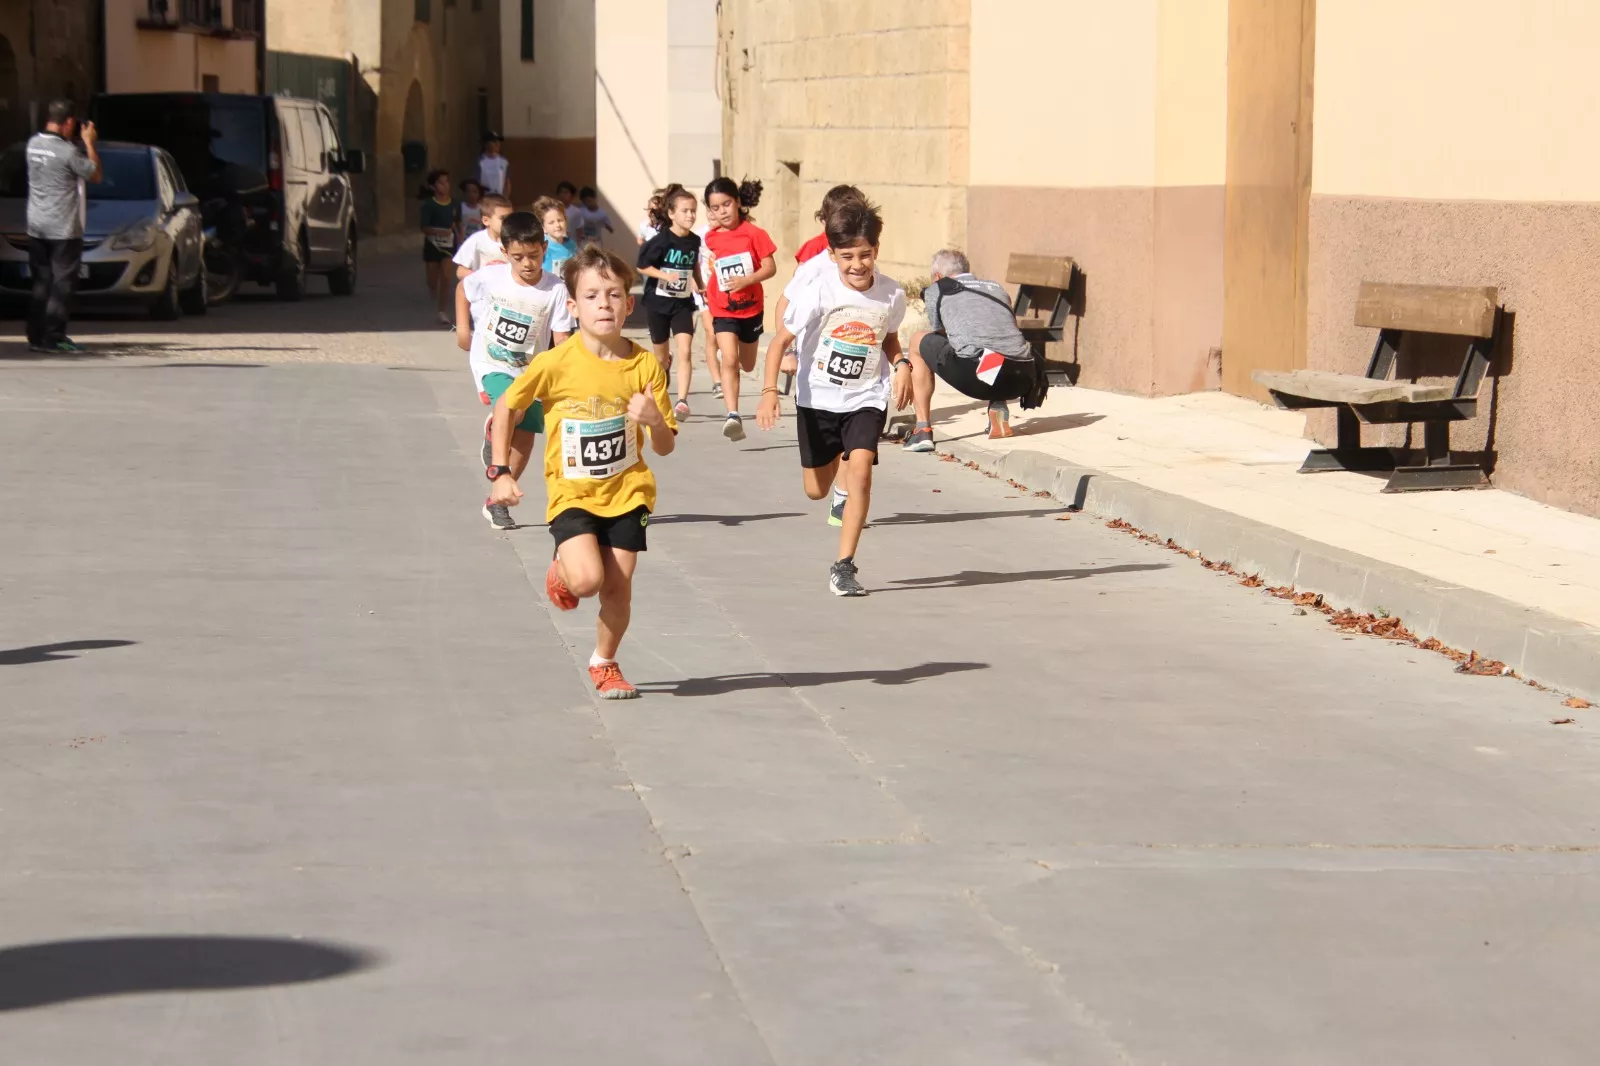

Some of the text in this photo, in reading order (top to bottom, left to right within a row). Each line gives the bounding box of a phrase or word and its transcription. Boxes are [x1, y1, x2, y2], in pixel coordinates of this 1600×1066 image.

[497, 321, 527, 341] 428
[829, 356, 863, 375] 436
[583, 435, 624, 461] 437
